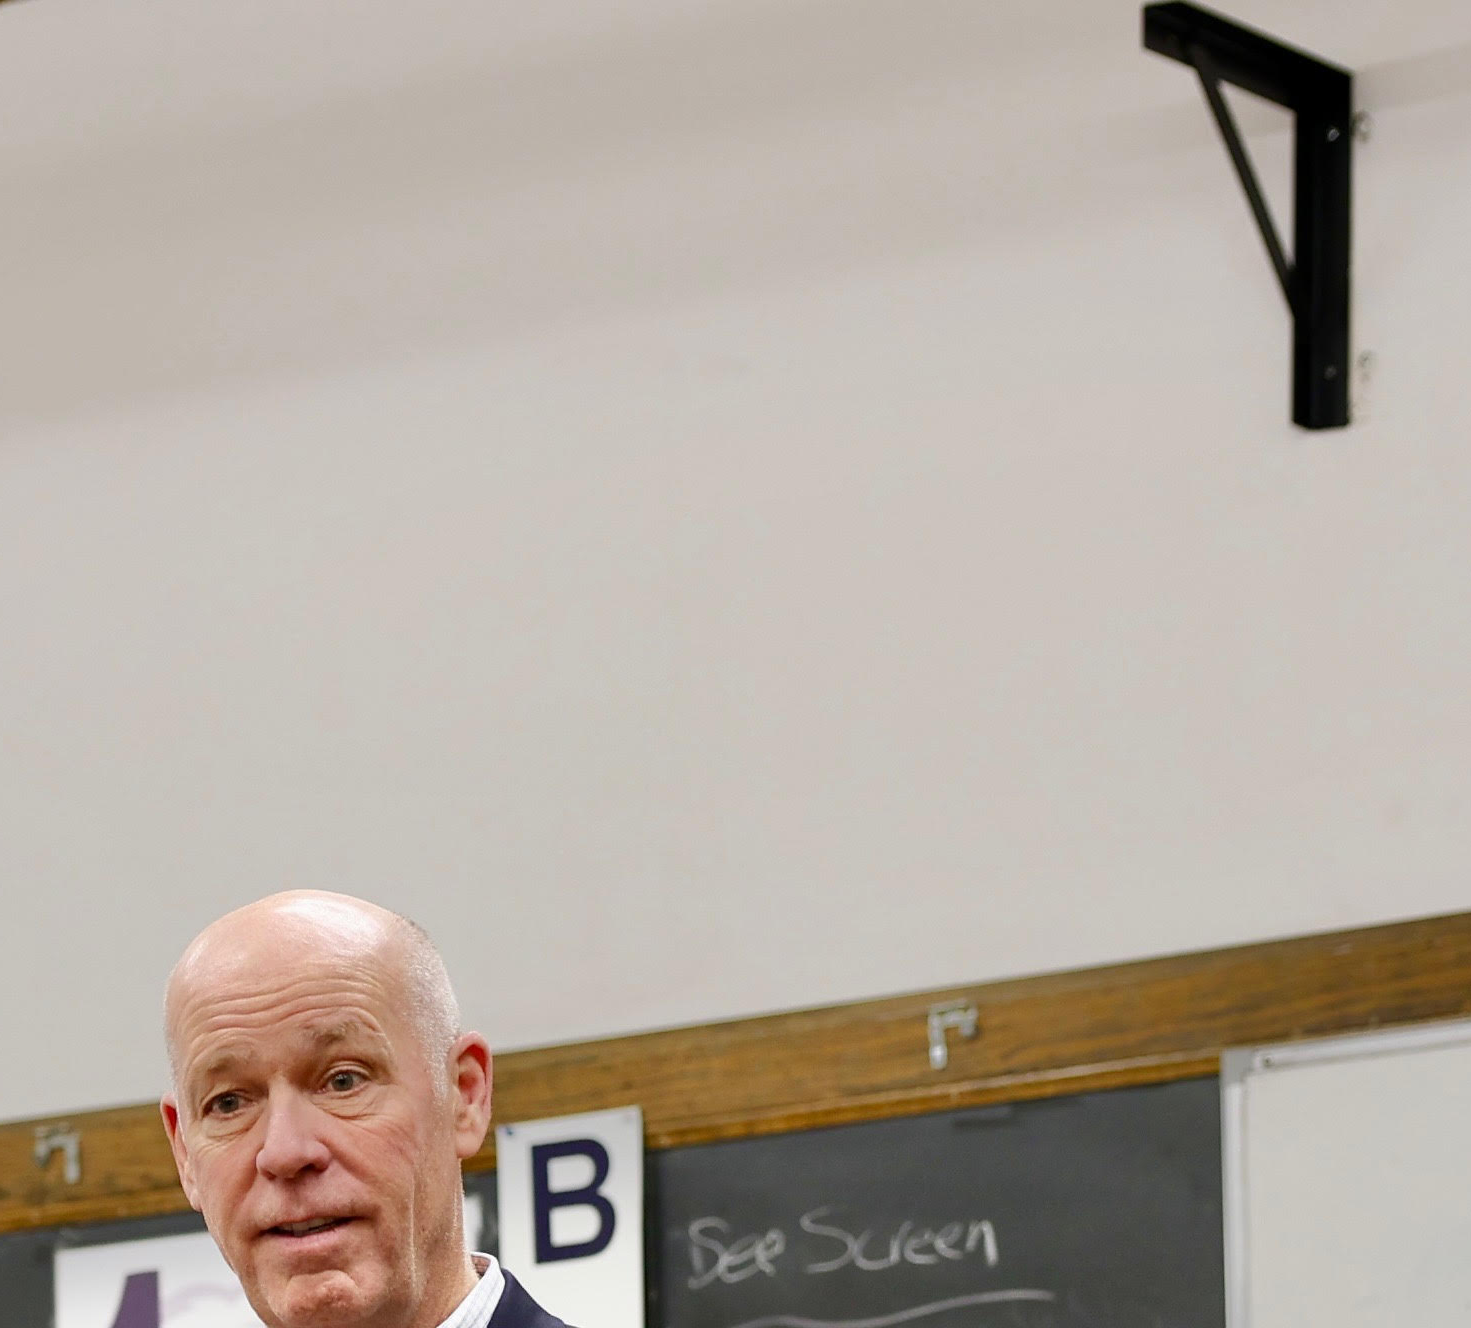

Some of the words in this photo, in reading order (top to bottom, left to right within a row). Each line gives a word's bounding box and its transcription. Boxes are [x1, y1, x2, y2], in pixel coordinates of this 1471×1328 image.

[531, 1138, 616, 1264] B
[688, 1217, 785, 1289] See
[799, 1206, 1000, 1273] Screen
